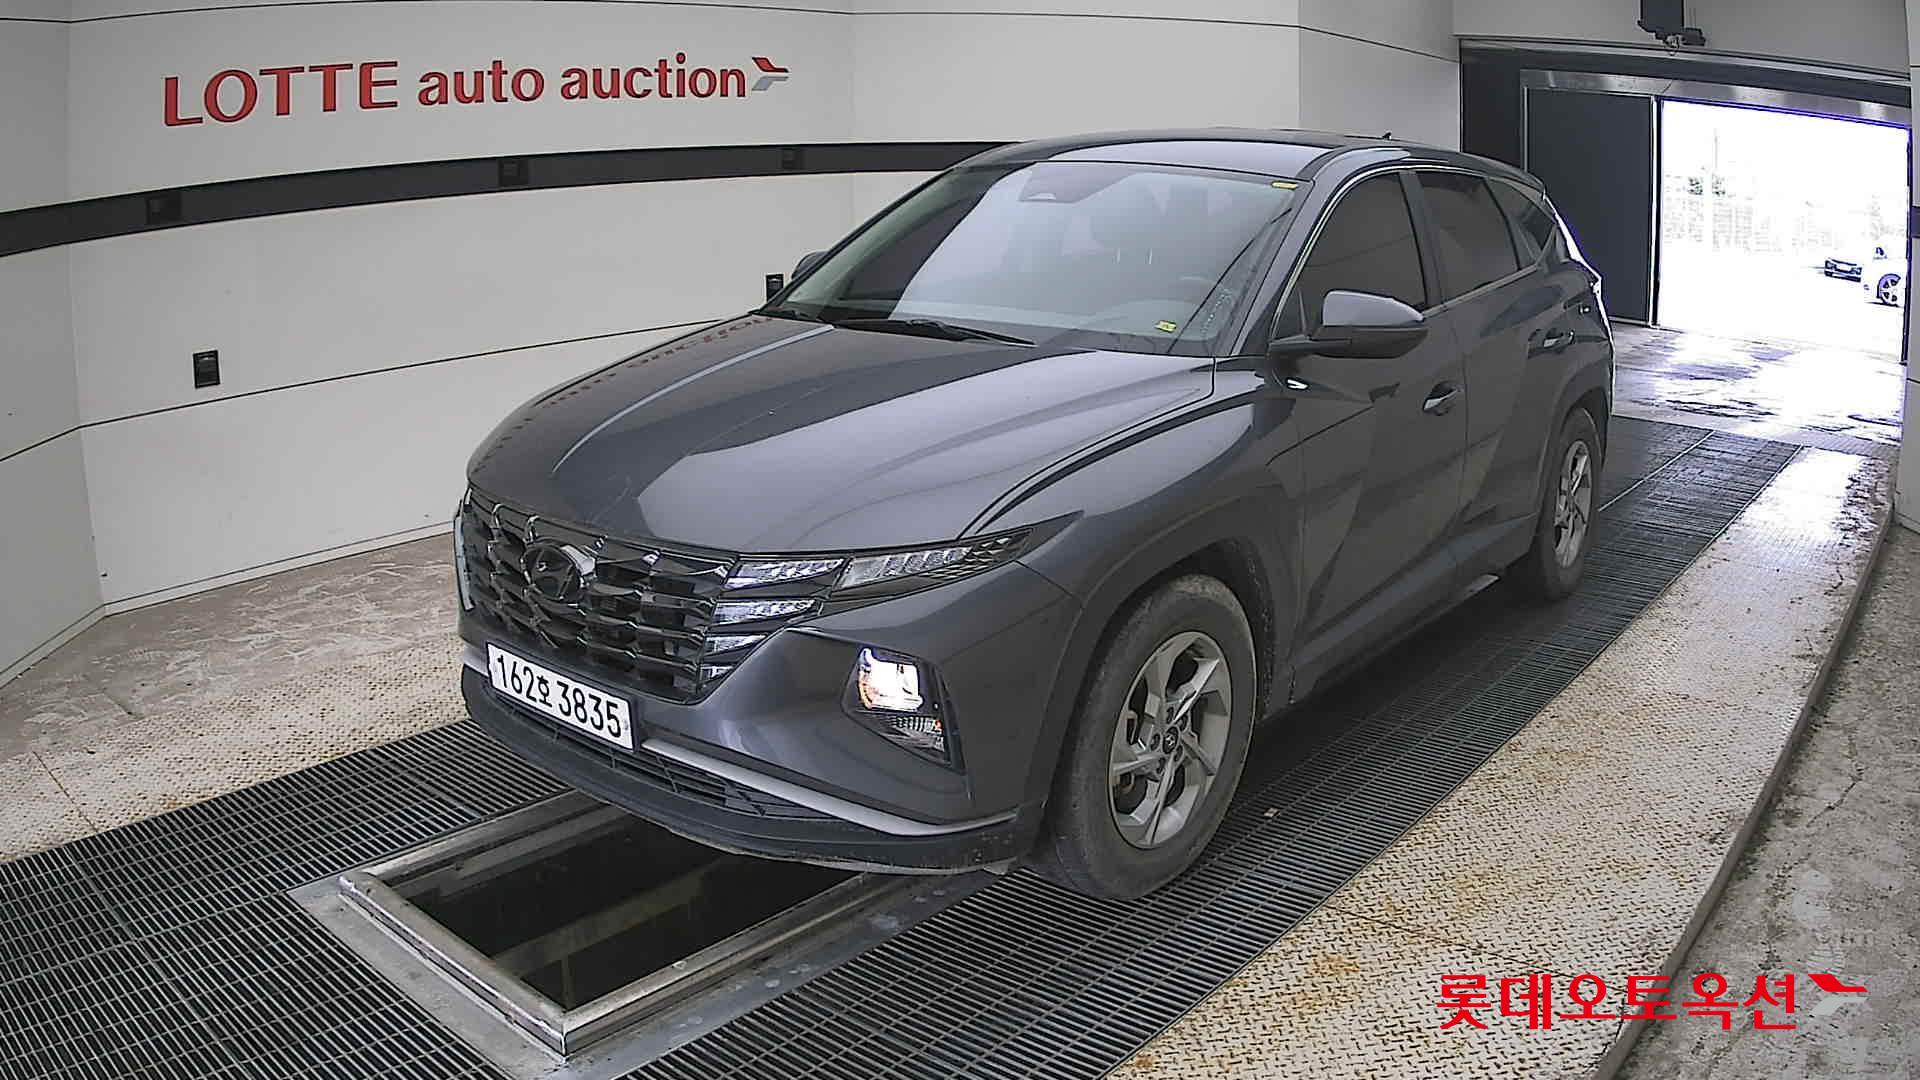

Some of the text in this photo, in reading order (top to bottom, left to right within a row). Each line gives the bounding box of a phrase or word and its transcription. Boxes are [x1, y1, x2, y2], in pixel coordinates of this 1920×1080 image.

[163, 51, 748, 126] LOTTE auto auction
[497, 654, 622, 739] 162호 3835
